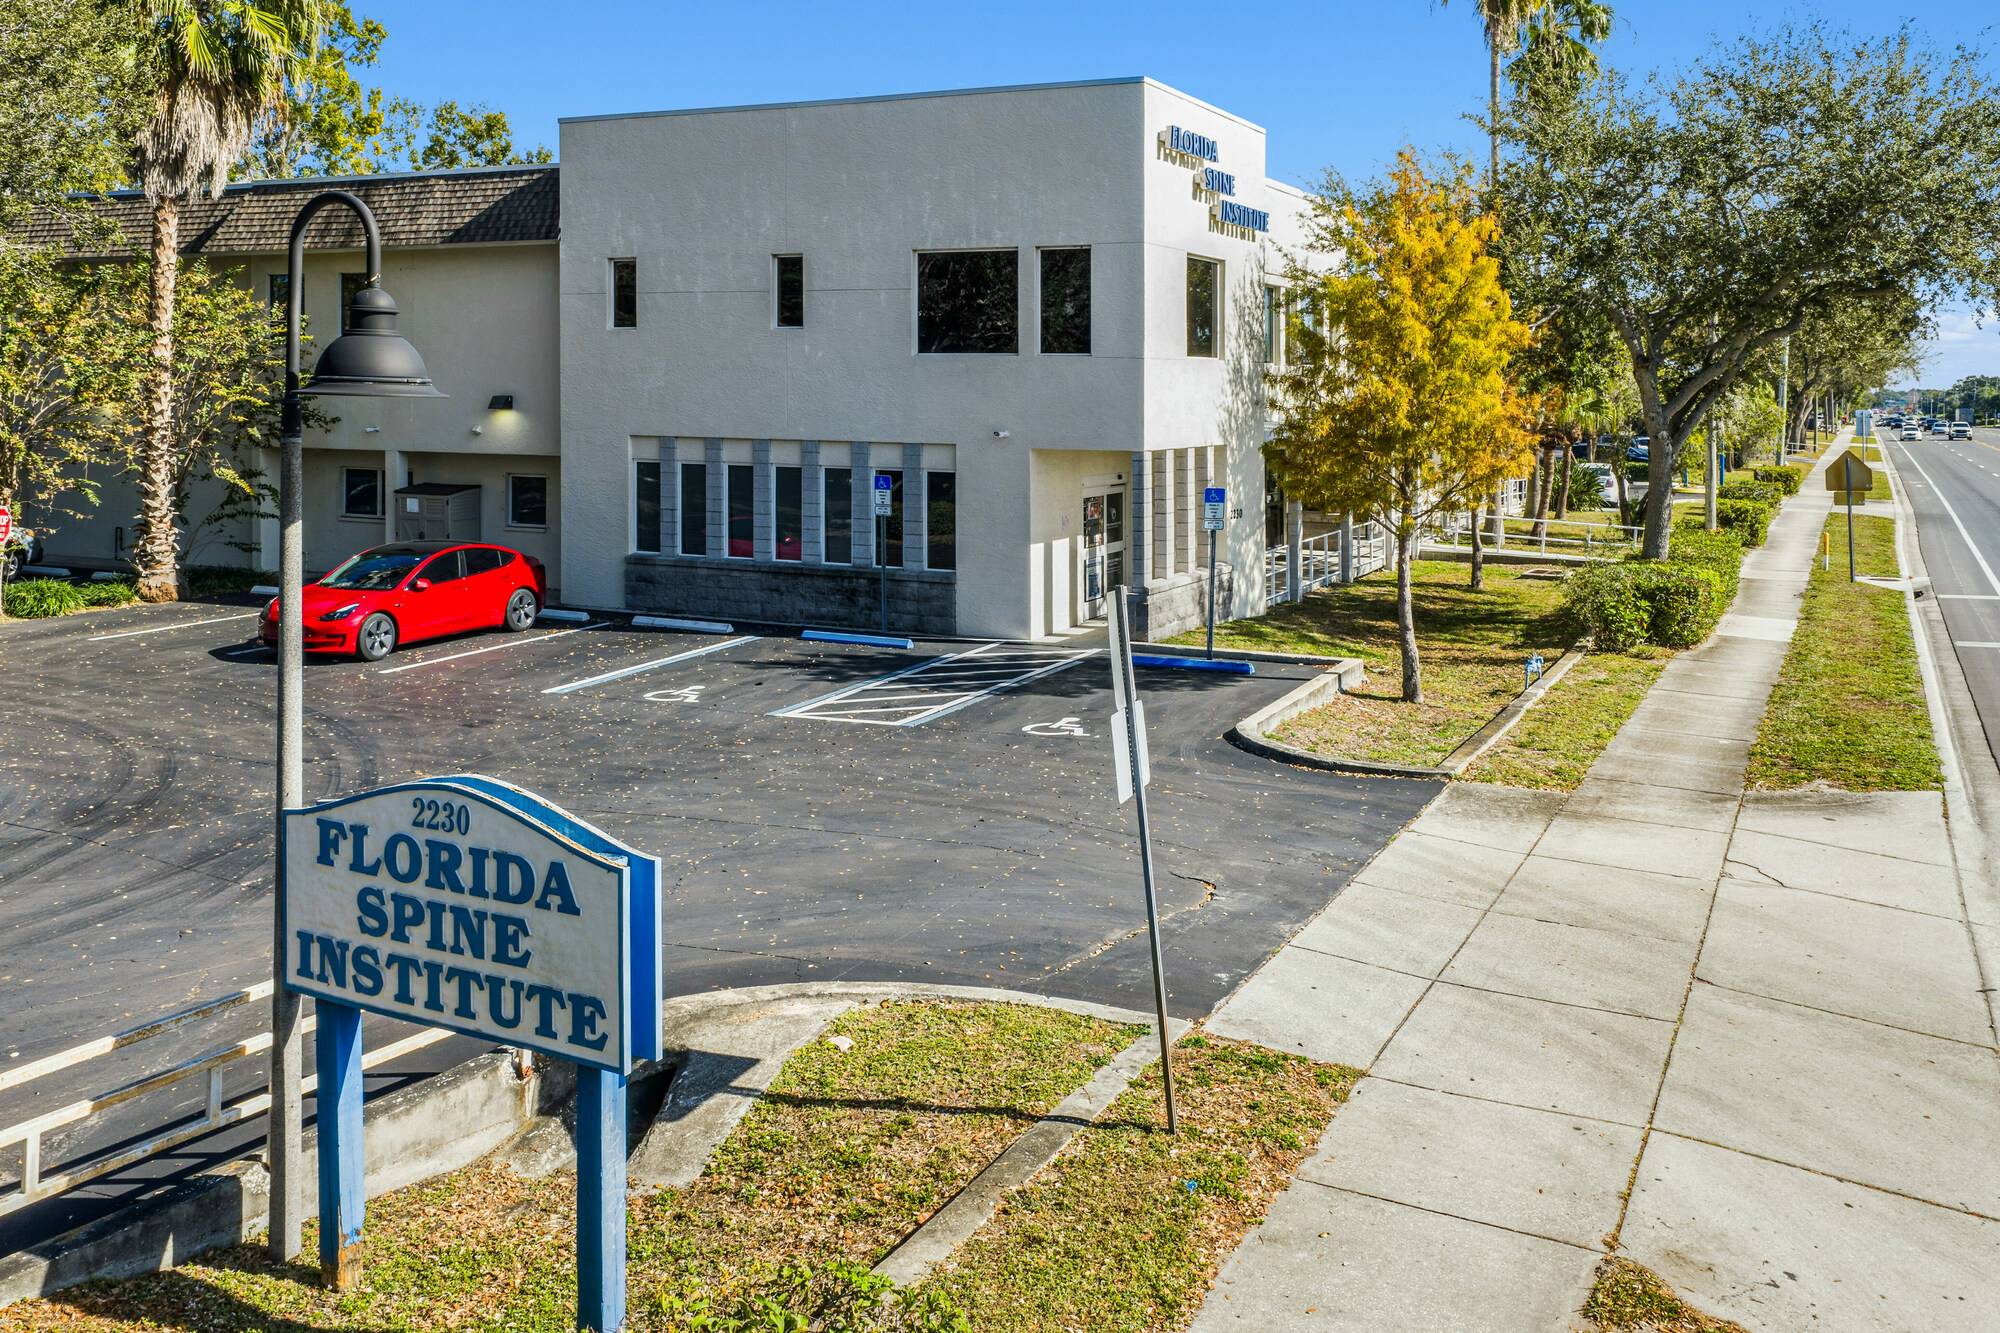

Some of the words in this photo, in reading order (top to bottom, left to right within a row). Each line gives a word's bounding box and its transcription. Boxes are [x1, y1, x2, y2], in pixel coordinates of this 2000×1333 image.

[1169, 125, 1219, 163] FLORIDA
[1204, 167, 1236, 197] SPINE
[1219, 200, 1270, 233] INSTITUTE
[411, 797, 471, 836] 2230
[316, 817, 582, 916] FLORIDA
[357, 885, 534, 969] SPINE
[296, 930, 610, 1053] INSTITUTE
